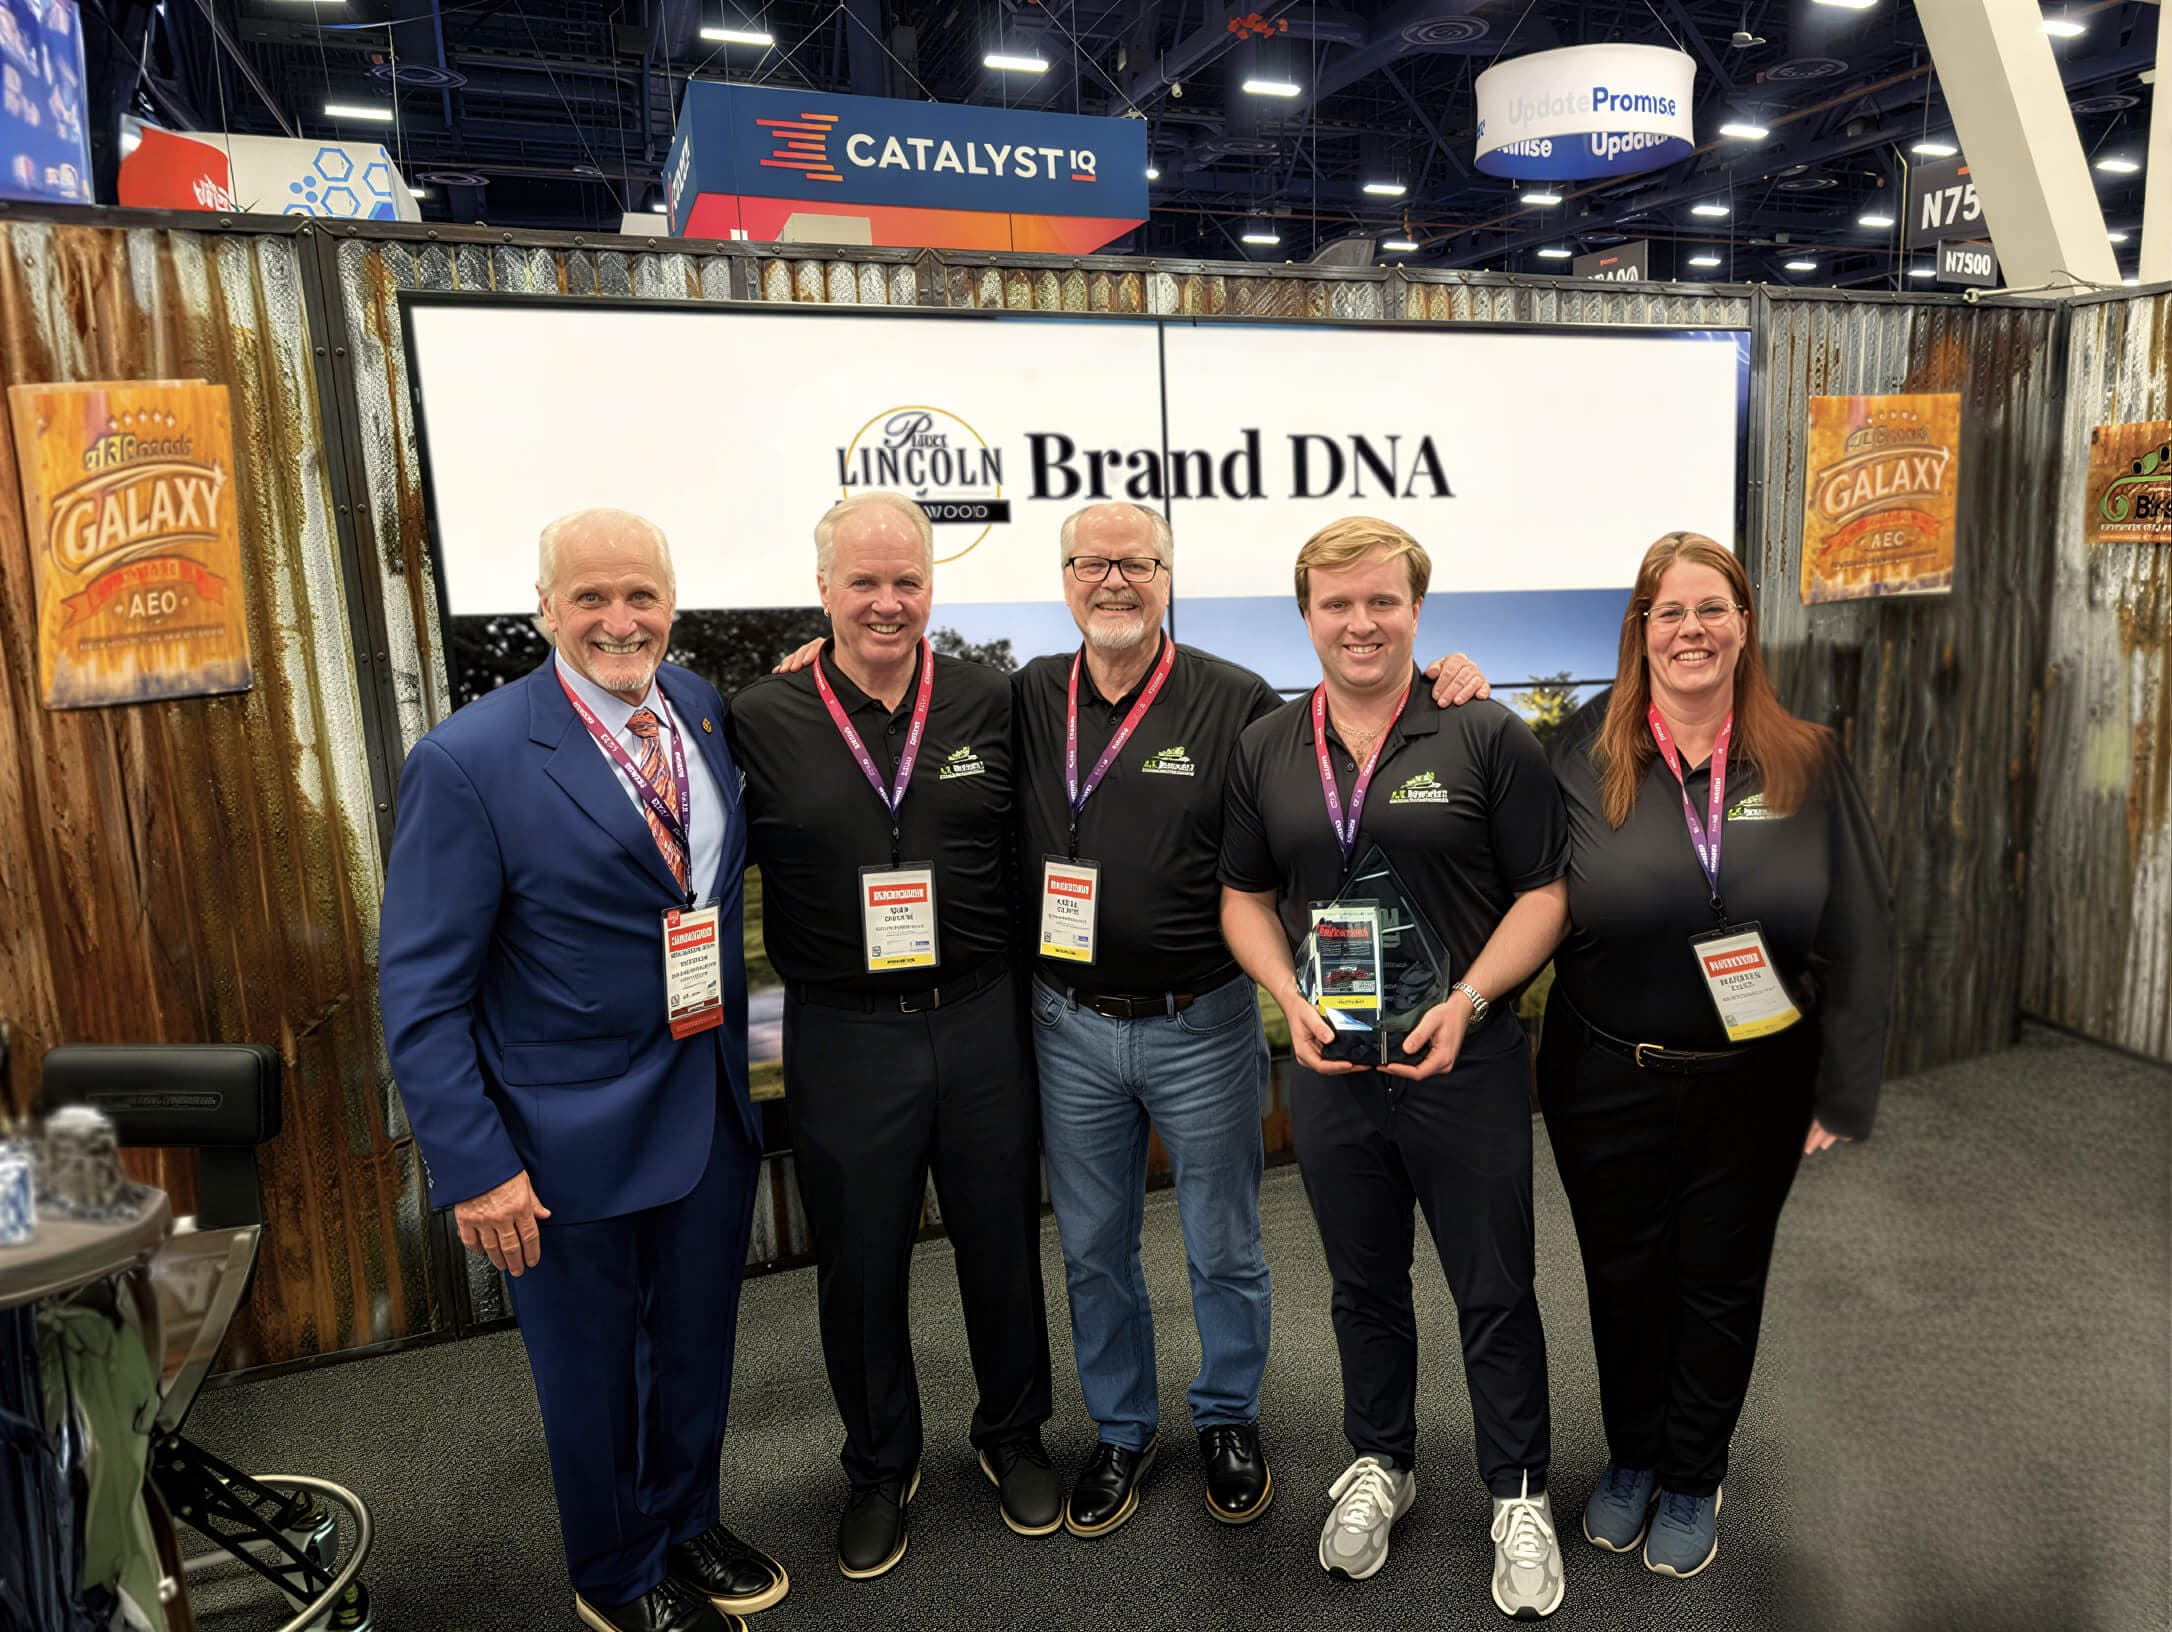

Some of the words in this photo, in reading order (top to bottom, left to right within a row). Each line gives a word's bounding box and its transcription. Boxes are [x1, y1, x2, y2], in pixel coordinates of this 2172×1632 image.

[846, 133, 1064, 179] CATALYST
[1070, 150, 1097, 175] IQ
[1921, 183, 1981, 231] N75
[1945, 250, 1992, 276] N7500
[836, 447, 1004, 487] LINCOLN
[1023, 428, 1268, 501] Brand
[1286, 434, 1457, 500] DNA
[1824, 456, 1948, 515] GALAXY
[63, 474, 224, 558] GALAXY
[924, 504, 989, 519] WOOD
[129, 590, 177, 619] AEO
